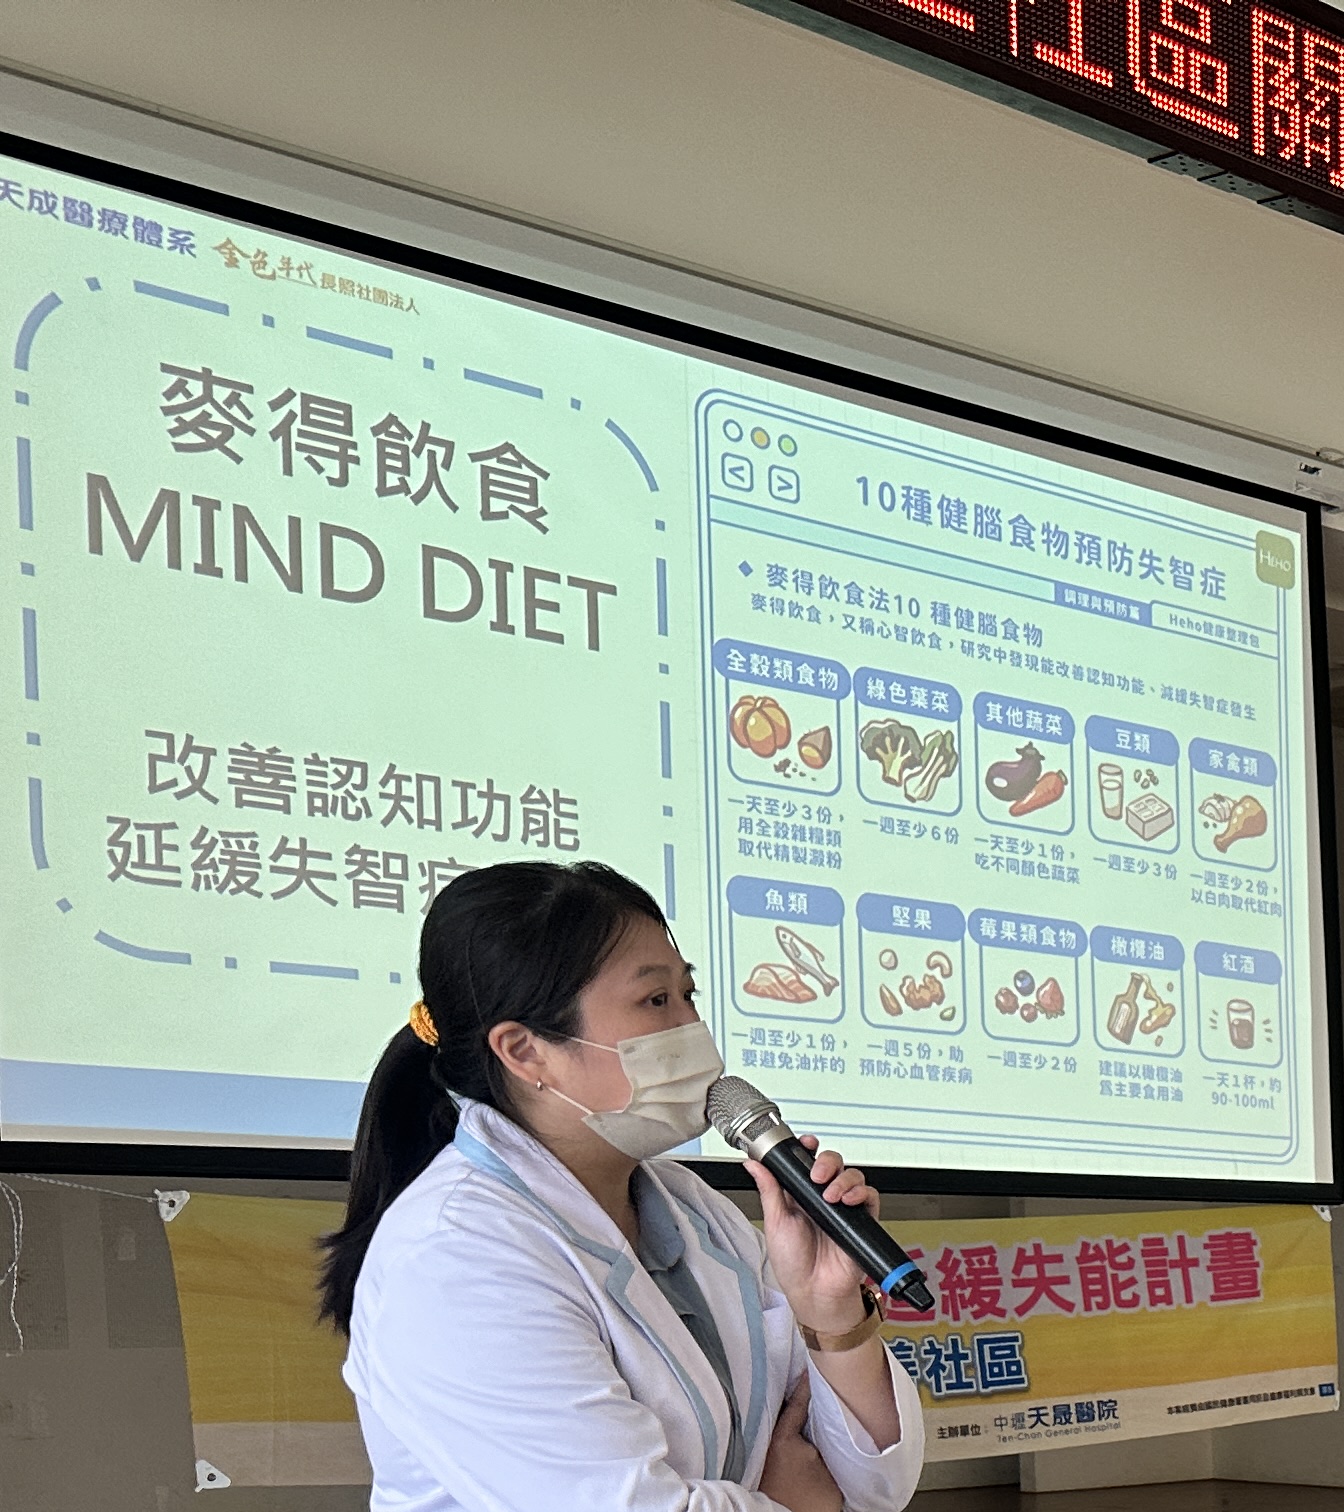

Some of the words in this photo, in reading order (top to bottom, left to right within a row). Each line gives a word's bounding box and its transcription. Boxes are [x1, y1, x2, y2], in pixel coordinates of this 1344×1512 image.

[0, 178, 197, 258] 天成醫療體系
[159, 361, 551, 535] 麥得飲食
[855, 476, 1227, 600] 10種健腦食物預防失智症
[86, 473, 385, 604] MIND
[421, 543, 617, 652] DIET
[726, 649, 839, 691] 全穀類食物
[866, 676, 950, 714] 綠色葉菜
[985, 702, 1063, 737] 其他蔬菜
[1115, 728, 1151, 756] 豆類
[1208, 749, 1259, 778] 家禽類
[144, 729, 580, 851] 改善認知功能
[764, 888, 809, 916] 魚類
[891, 904, 932, 931] 堅果
[979, 917, 1077, 951] 莓果類食物
[1110, 936, 1165, 961] 橄欖油
[1222, 952, 1255, 975] 紅酒
[860, 1058, 973, 1084] 預防心血管疾病
[1046, 1426, 1082, 1439] General
[1084, 1421, 1122, 1433] Hospital
